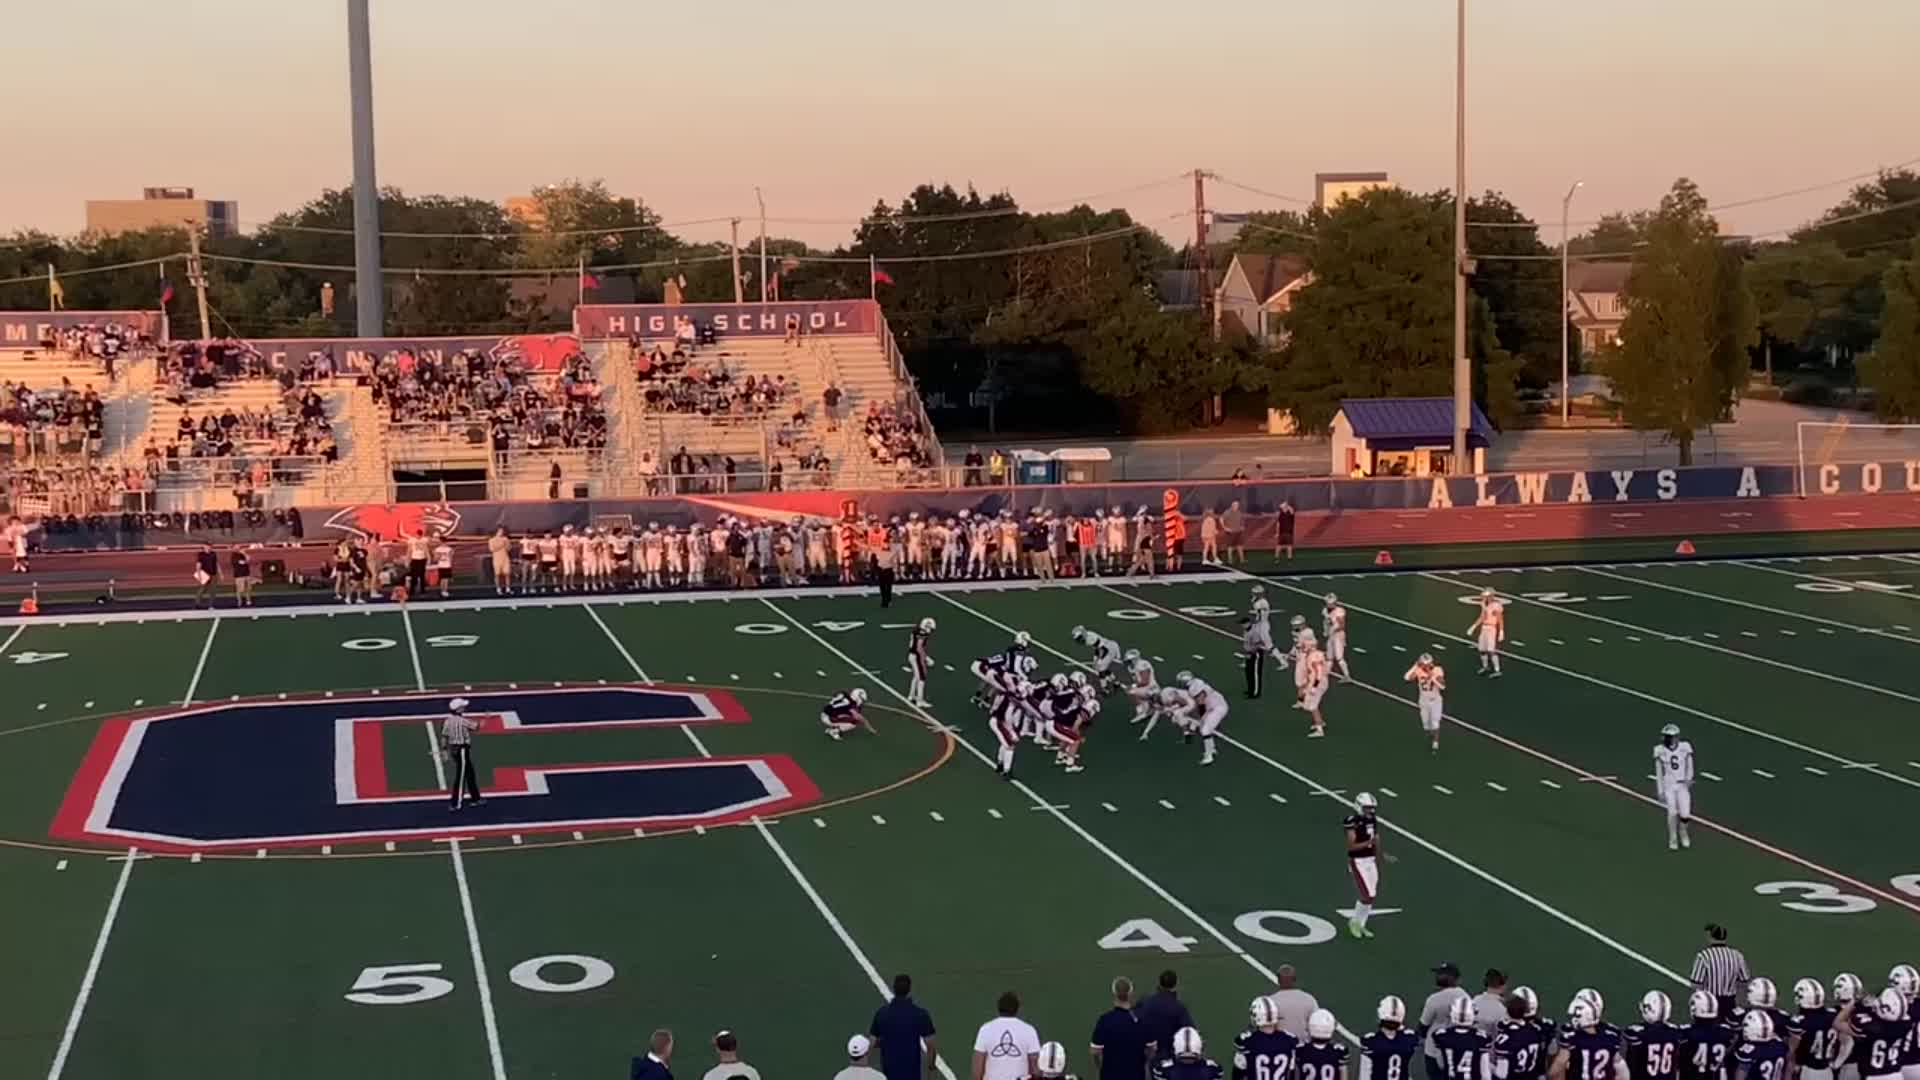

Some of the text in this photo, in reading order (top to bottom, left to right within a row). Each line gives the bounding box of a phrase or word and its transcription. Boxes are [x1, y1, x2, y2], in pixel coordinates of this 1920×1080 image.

[1428, 469, 1678, 509] ALWAYS
[1736, 466, 1760, 497] A
[1670, 755, 1679, 770] 6
[1445, 1047, 1473, 1080] 14
[1581, 1048, 1611, 1080] 12
[1647, 1042, 1674, 1076] 56
[1692, 1042, 1726, 1073] 43
